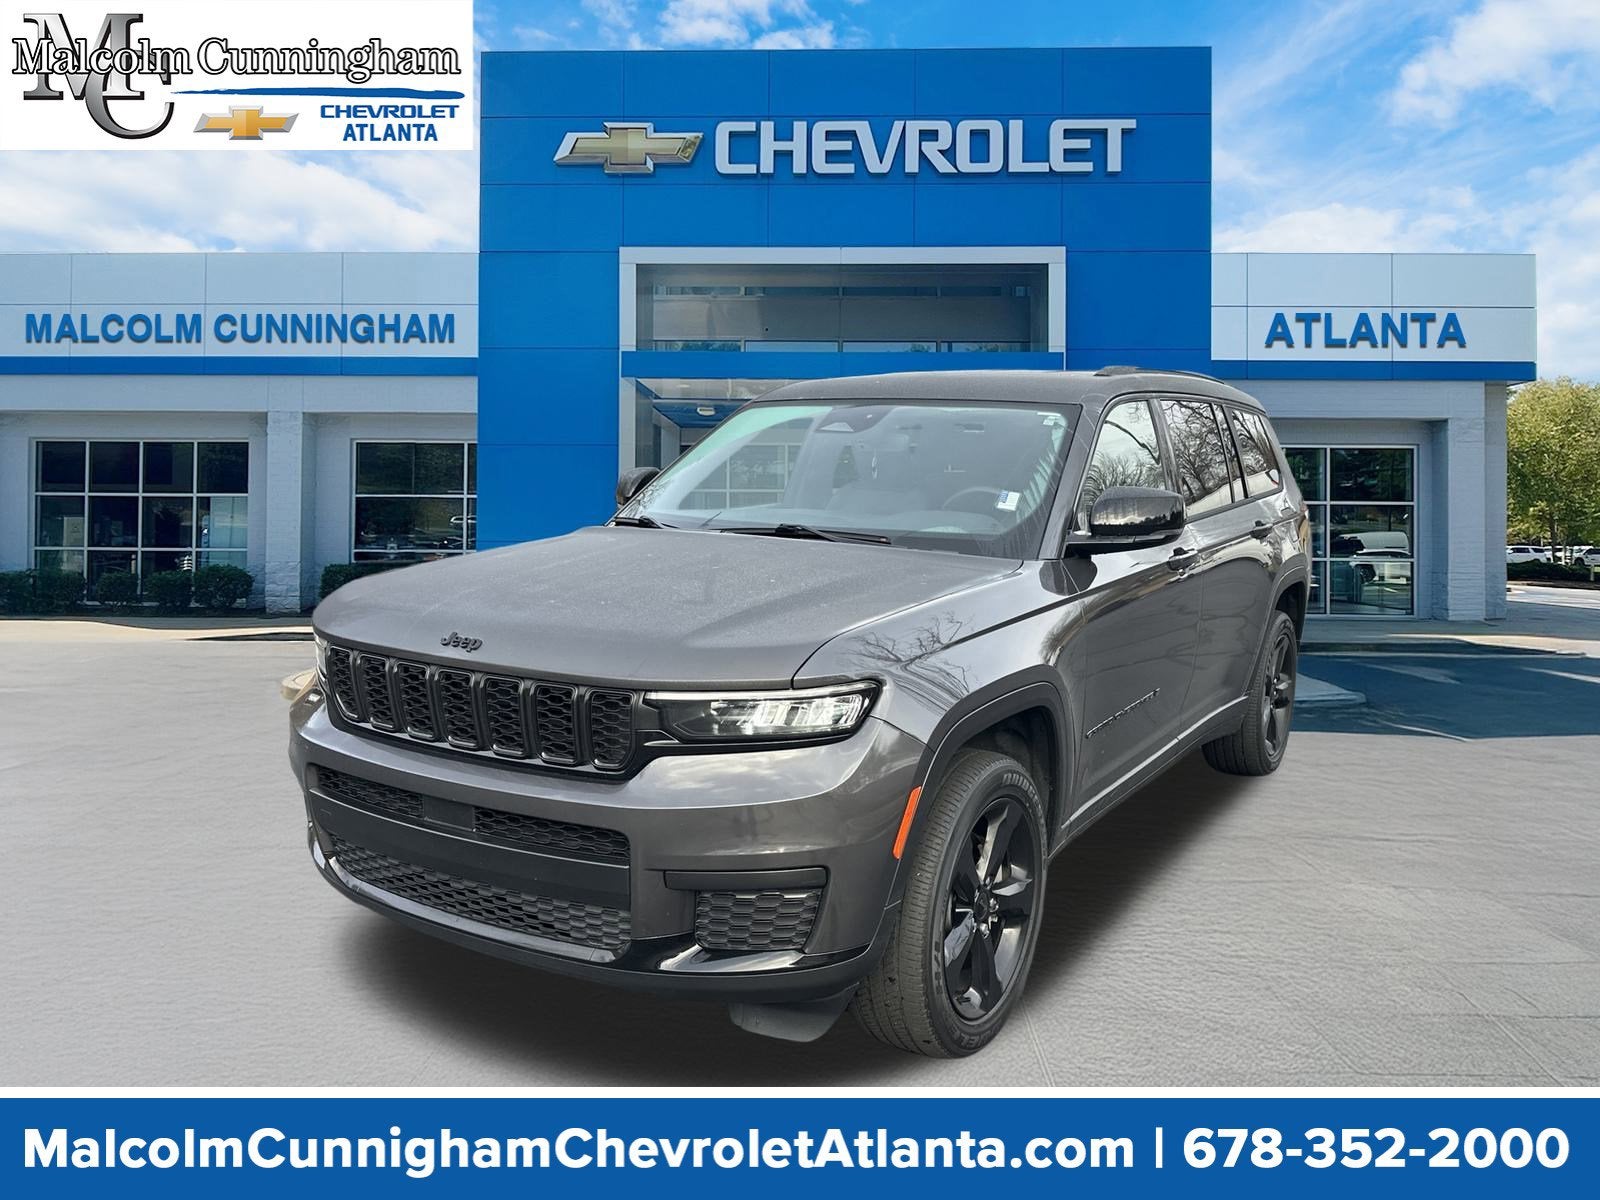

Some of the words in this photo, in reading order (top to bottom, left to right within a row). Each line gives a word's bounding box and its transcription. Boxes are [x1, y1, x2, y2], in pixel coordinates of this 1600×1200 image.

[715, 119, 1137, 175] CHEVROLET
[25, 313, 201, 344] MALCOLM
[213, 313, 456, 344] CUNNINGHAM
[1264, 312, 1467, 349] ATLANTA
[440, 631, 483, 653] Jeep
